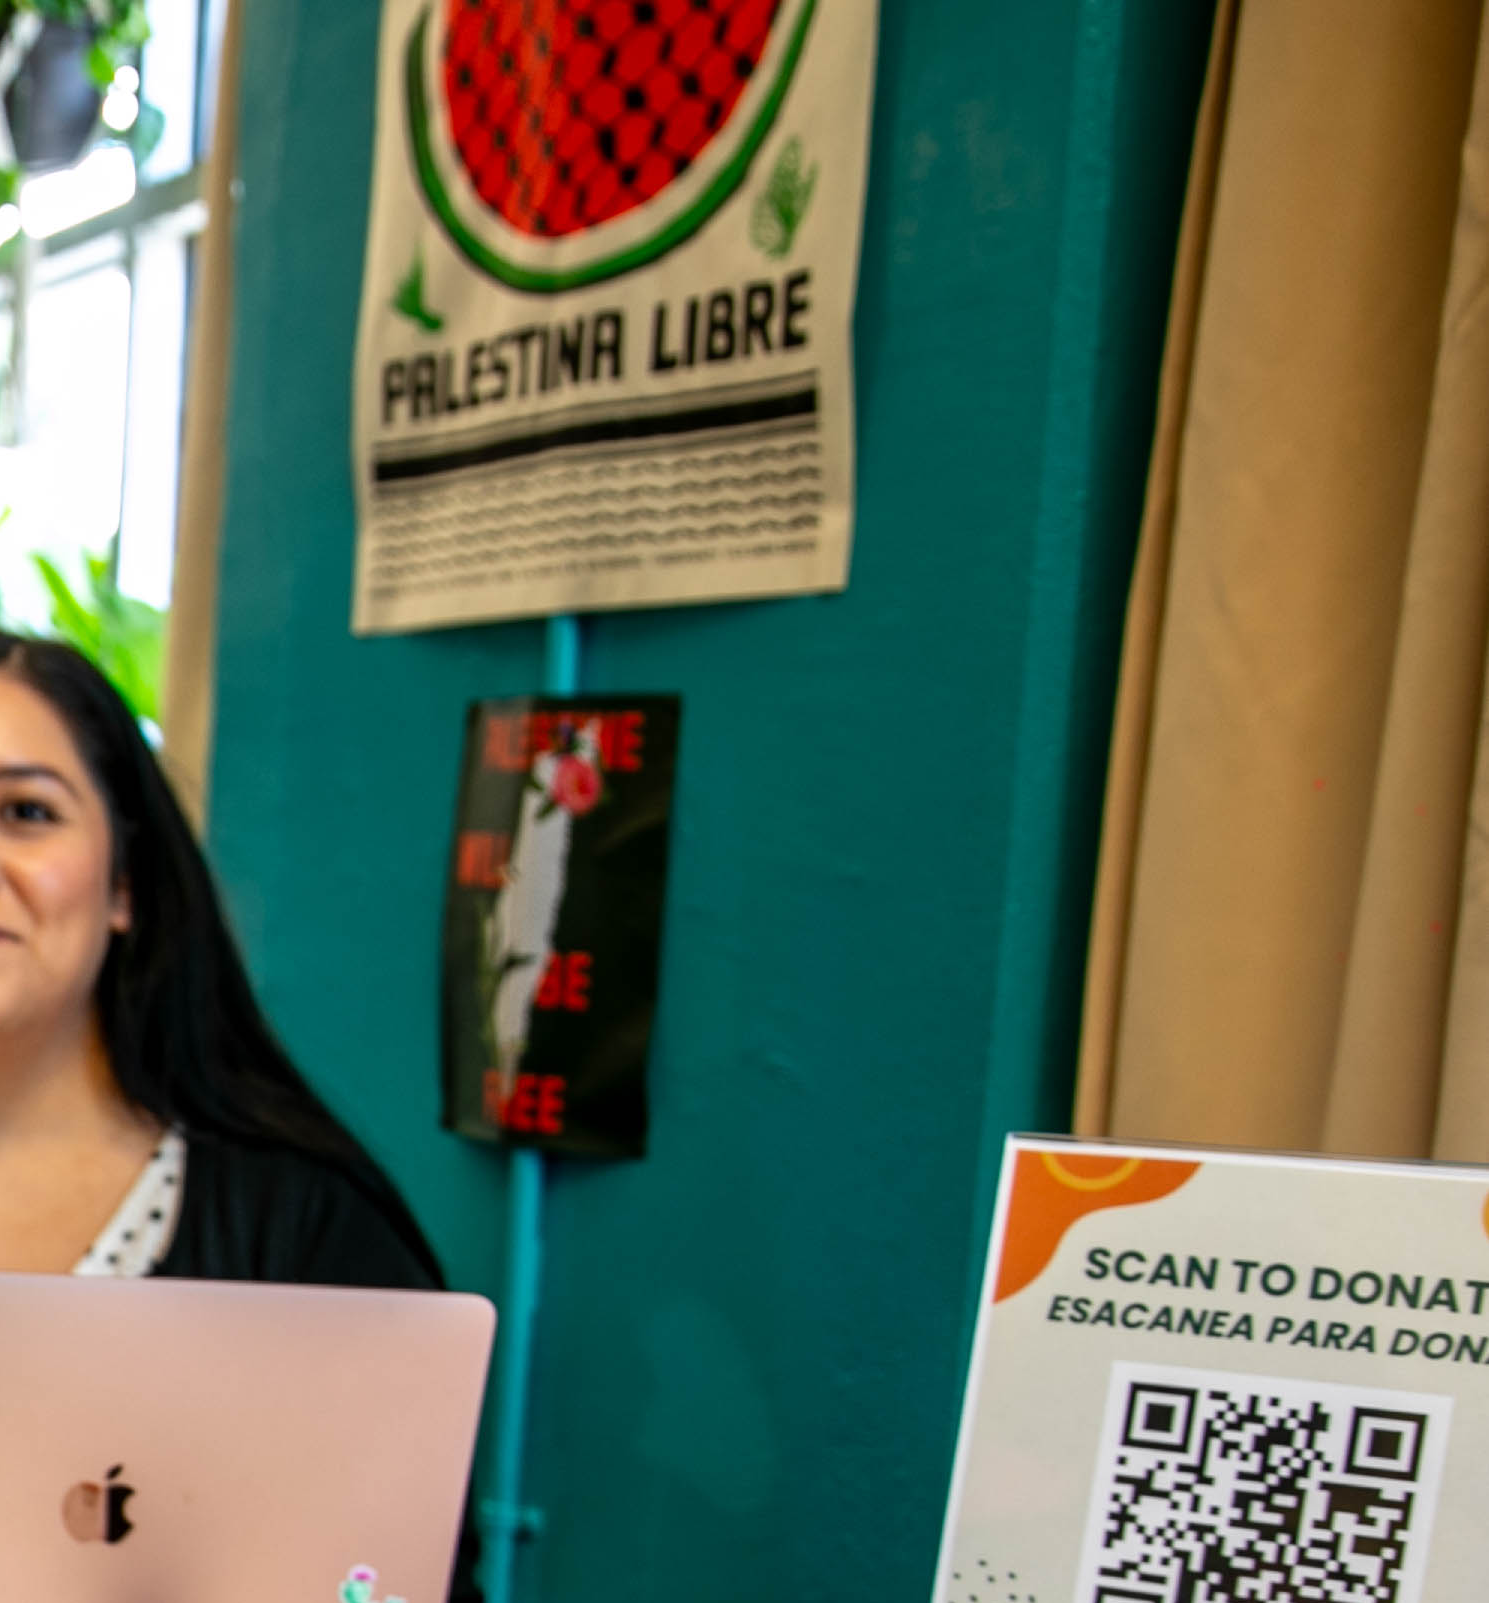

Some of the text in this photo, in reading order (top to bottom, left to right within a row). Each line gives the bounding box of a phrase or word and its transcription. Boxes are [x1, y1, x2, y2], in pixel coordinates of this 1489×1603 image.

[380, 269, 812, 427] PALESTINA LIBRE
[1084, 1247, 1489, 1316] SCAN TO DONAT
[1047, 1294, 1256, 1342] ESACANEA
[1265, 1316, 1377, 1354] PARA
